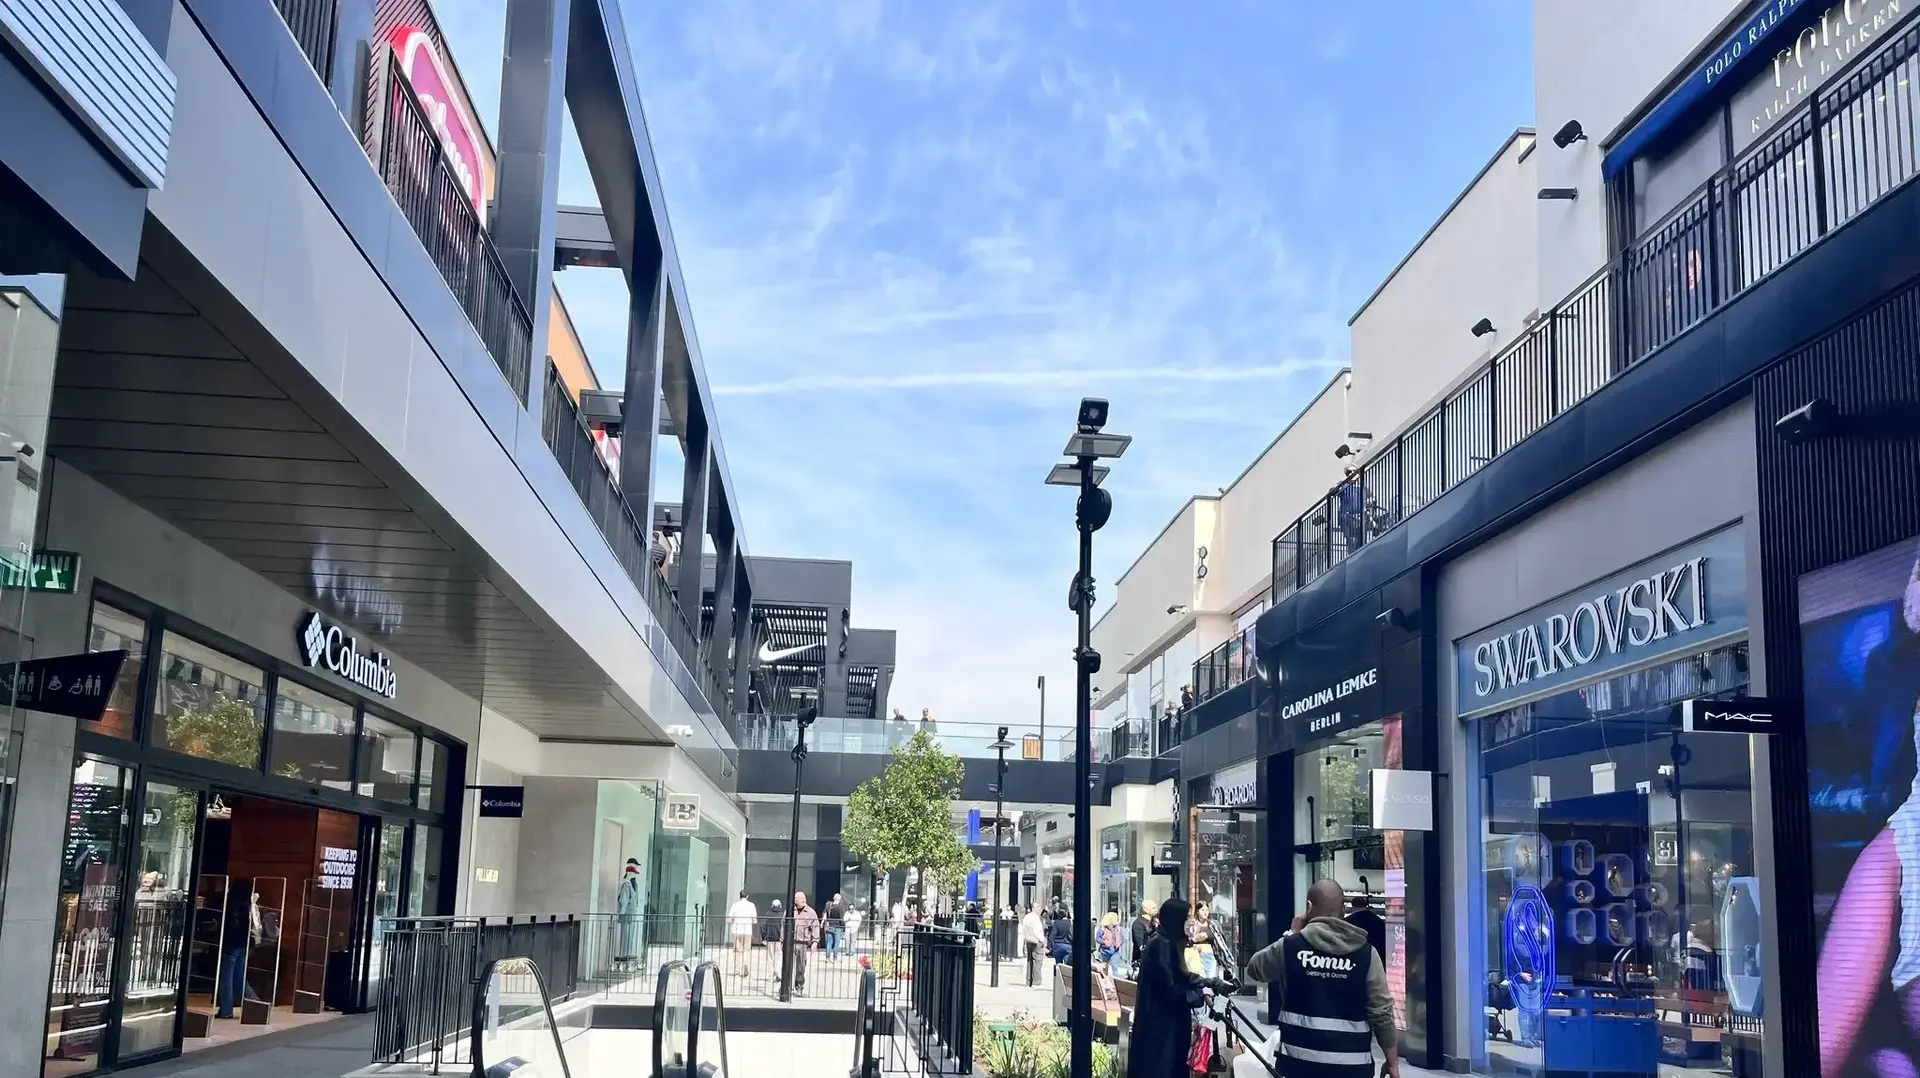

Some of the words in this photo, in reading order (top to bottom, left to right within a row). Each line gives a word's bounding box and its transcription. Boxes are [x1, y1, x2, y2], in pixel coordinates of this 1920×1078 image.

[1705, 41, 1742, 84] POLO
[1474, 556, 1708, 698] SWAROVSKI
[325, 625, 397, 699] Columbia
[1281, 687, 1335, 720] CAROLINA
[1335, 667, 1378, 699] LEMKE
[1310, 711, 1342, 733] BERLIN
[489, 799, 521, 808] Columbia
[323, 861, 356, 876] OUTDOORS
[84, 884, 116, 898] WINTER
[322, 876, 340, 889] SINCE
[87, 899, 109, 912] SALE
